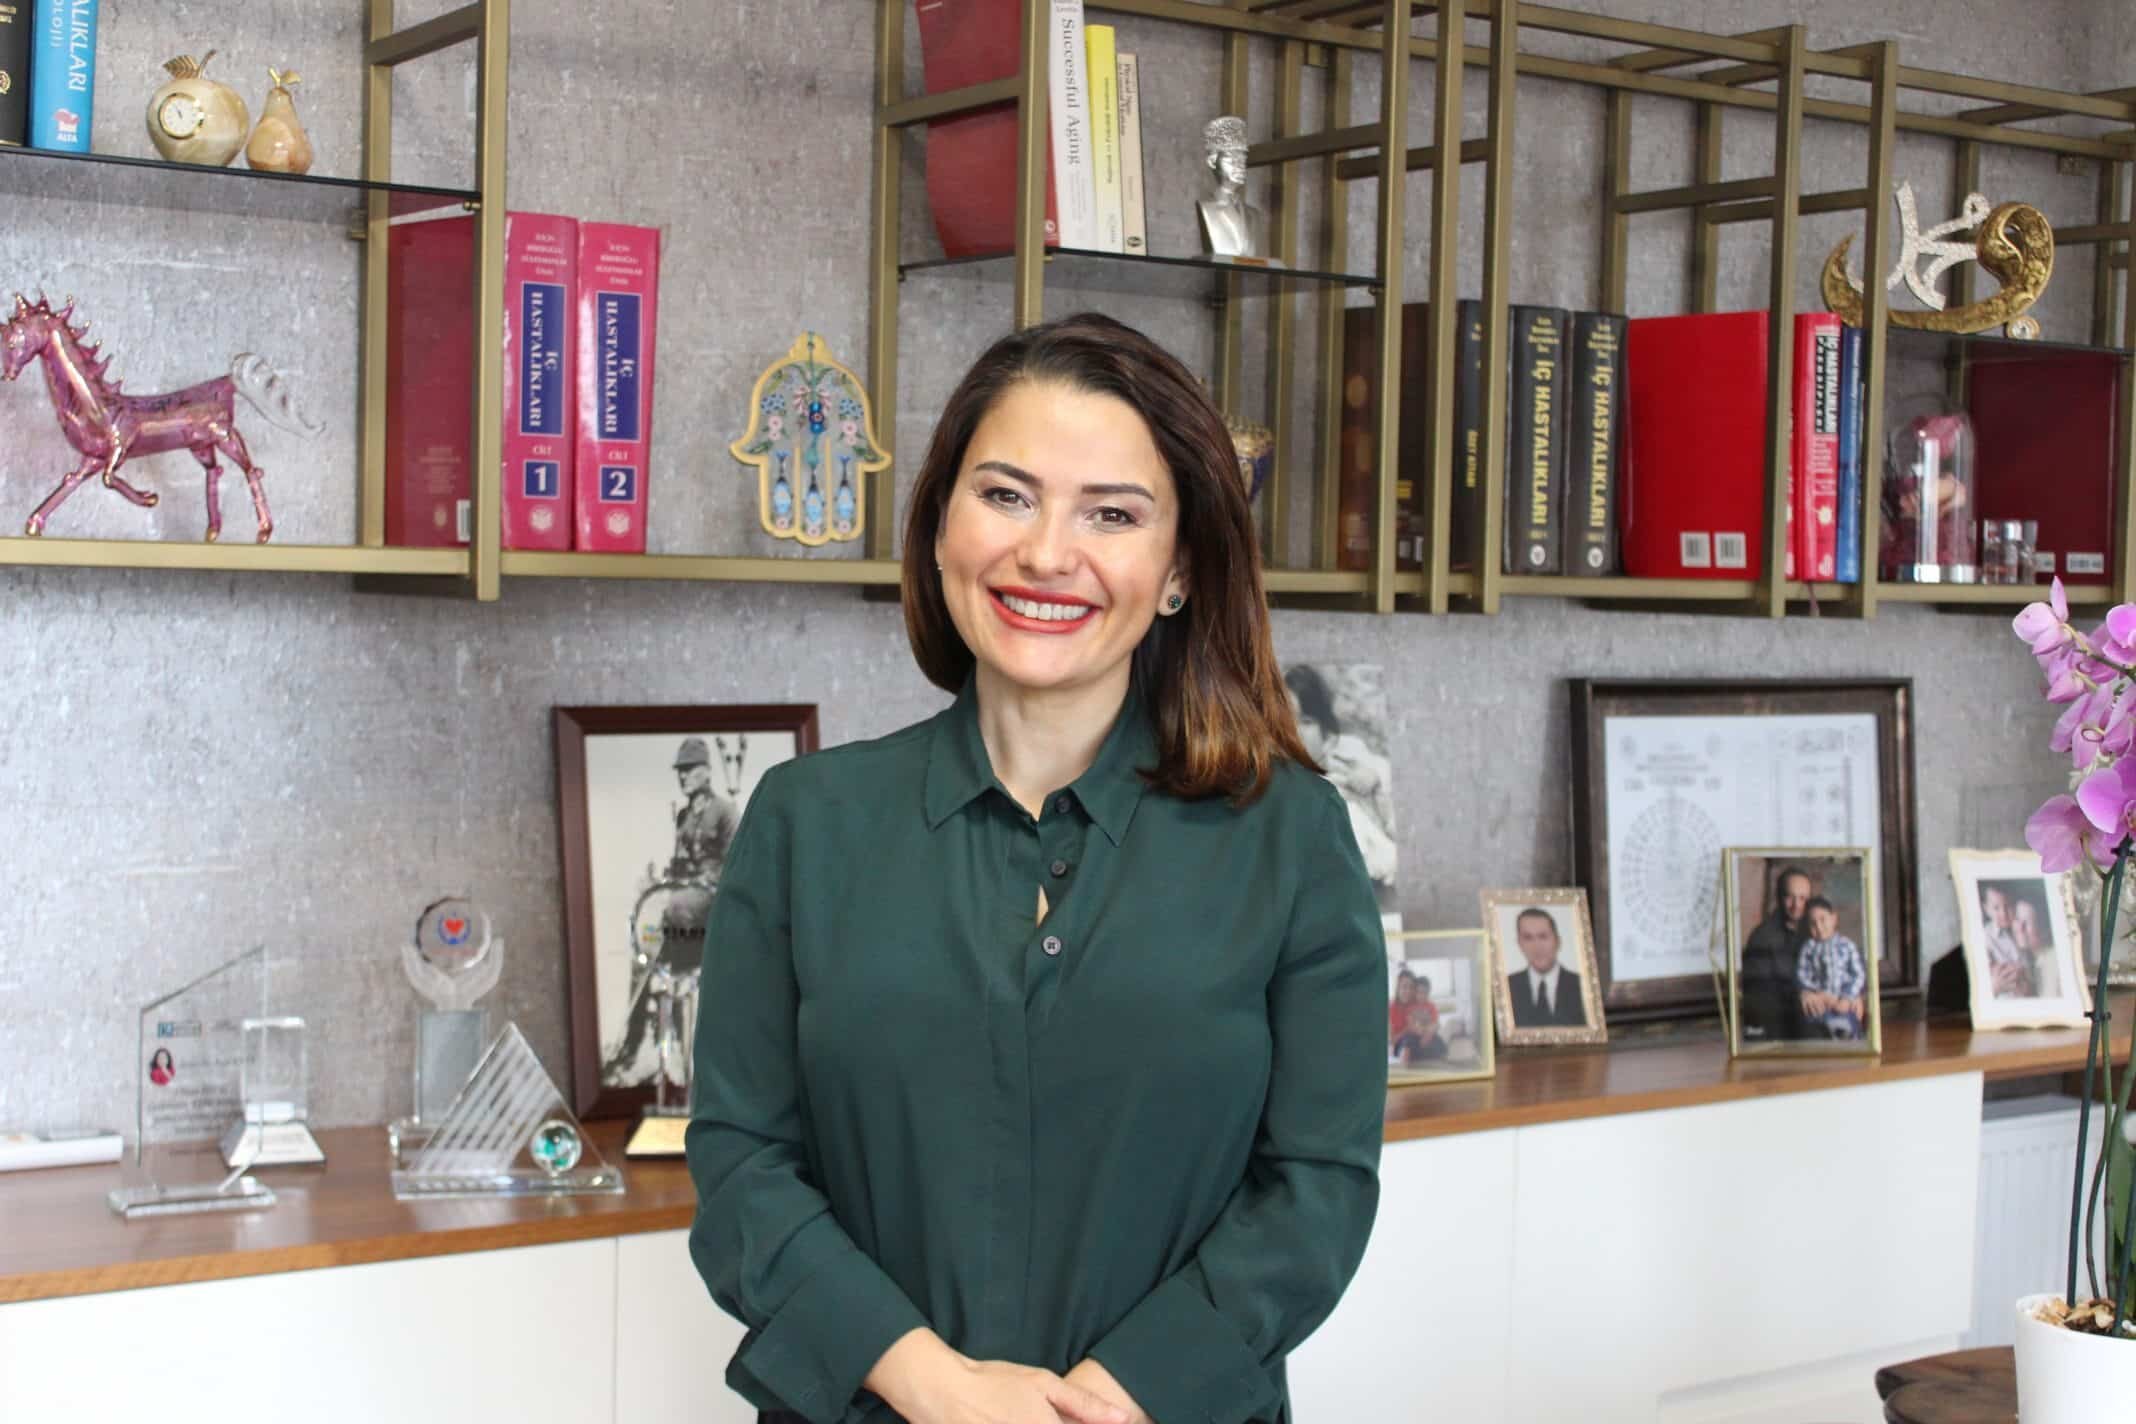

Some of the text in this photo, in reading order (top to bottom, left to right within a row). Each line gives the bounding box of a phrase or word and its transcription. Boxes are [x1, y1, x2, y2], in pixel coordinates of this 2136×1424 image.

[1062, 18, 1080, 108] Successful
[1066, 114, 1081, 165] Aging
[529, 292, 543, 427] HASTALIKLARI
[605, 301, 618, 432] HASTALIKLARI
[1531, 360, 1554, 381] İÇ
[1591, 365, 1613, 387] İÇ
[534, 466, 547, 492] 1
[609, 471, 627, 497] 2
[1532, 386, 1551, 524] HASTALIKLARI
[1590, 391, 1609, 527] HASTALIKLARI
